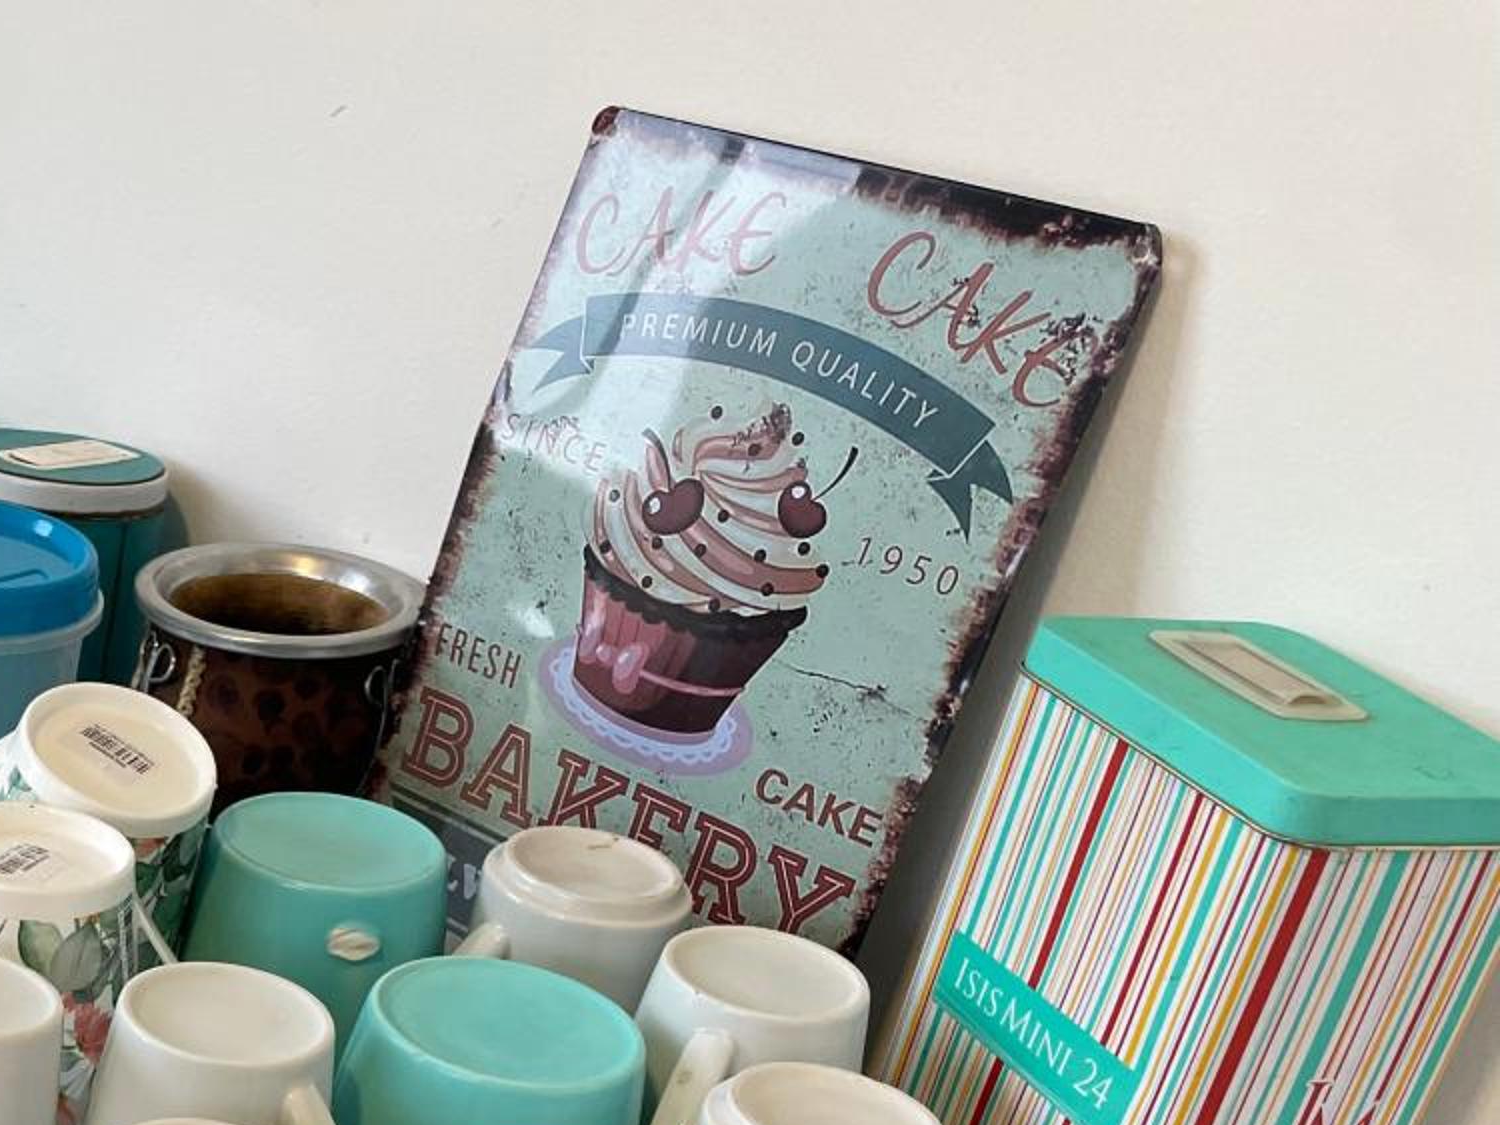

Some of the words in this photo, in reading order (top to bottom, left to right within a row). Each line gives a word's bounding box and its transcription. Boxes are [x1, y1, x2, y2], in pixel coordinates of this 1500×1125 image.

[575, 185, 787, 277] CAKE
[866, 230, 1098, 407] CAKE
[620, 311, 780, 358] PREMIUM
[790, 340, 940, 429] QUALITY
[501, 412, 606, 474] SINCE
[858, 536, 959, 596] 1950
[435, 622, 522, 689] FRESH
[400, 685, 857, 935] BAKERY
[753, 768, 884, 848] CAKE
[954, 957, 1004, 1018] ISIS
[1000, 997, 1073, 1077] MINI
[1073, 1057, 1114, 1110] 24
